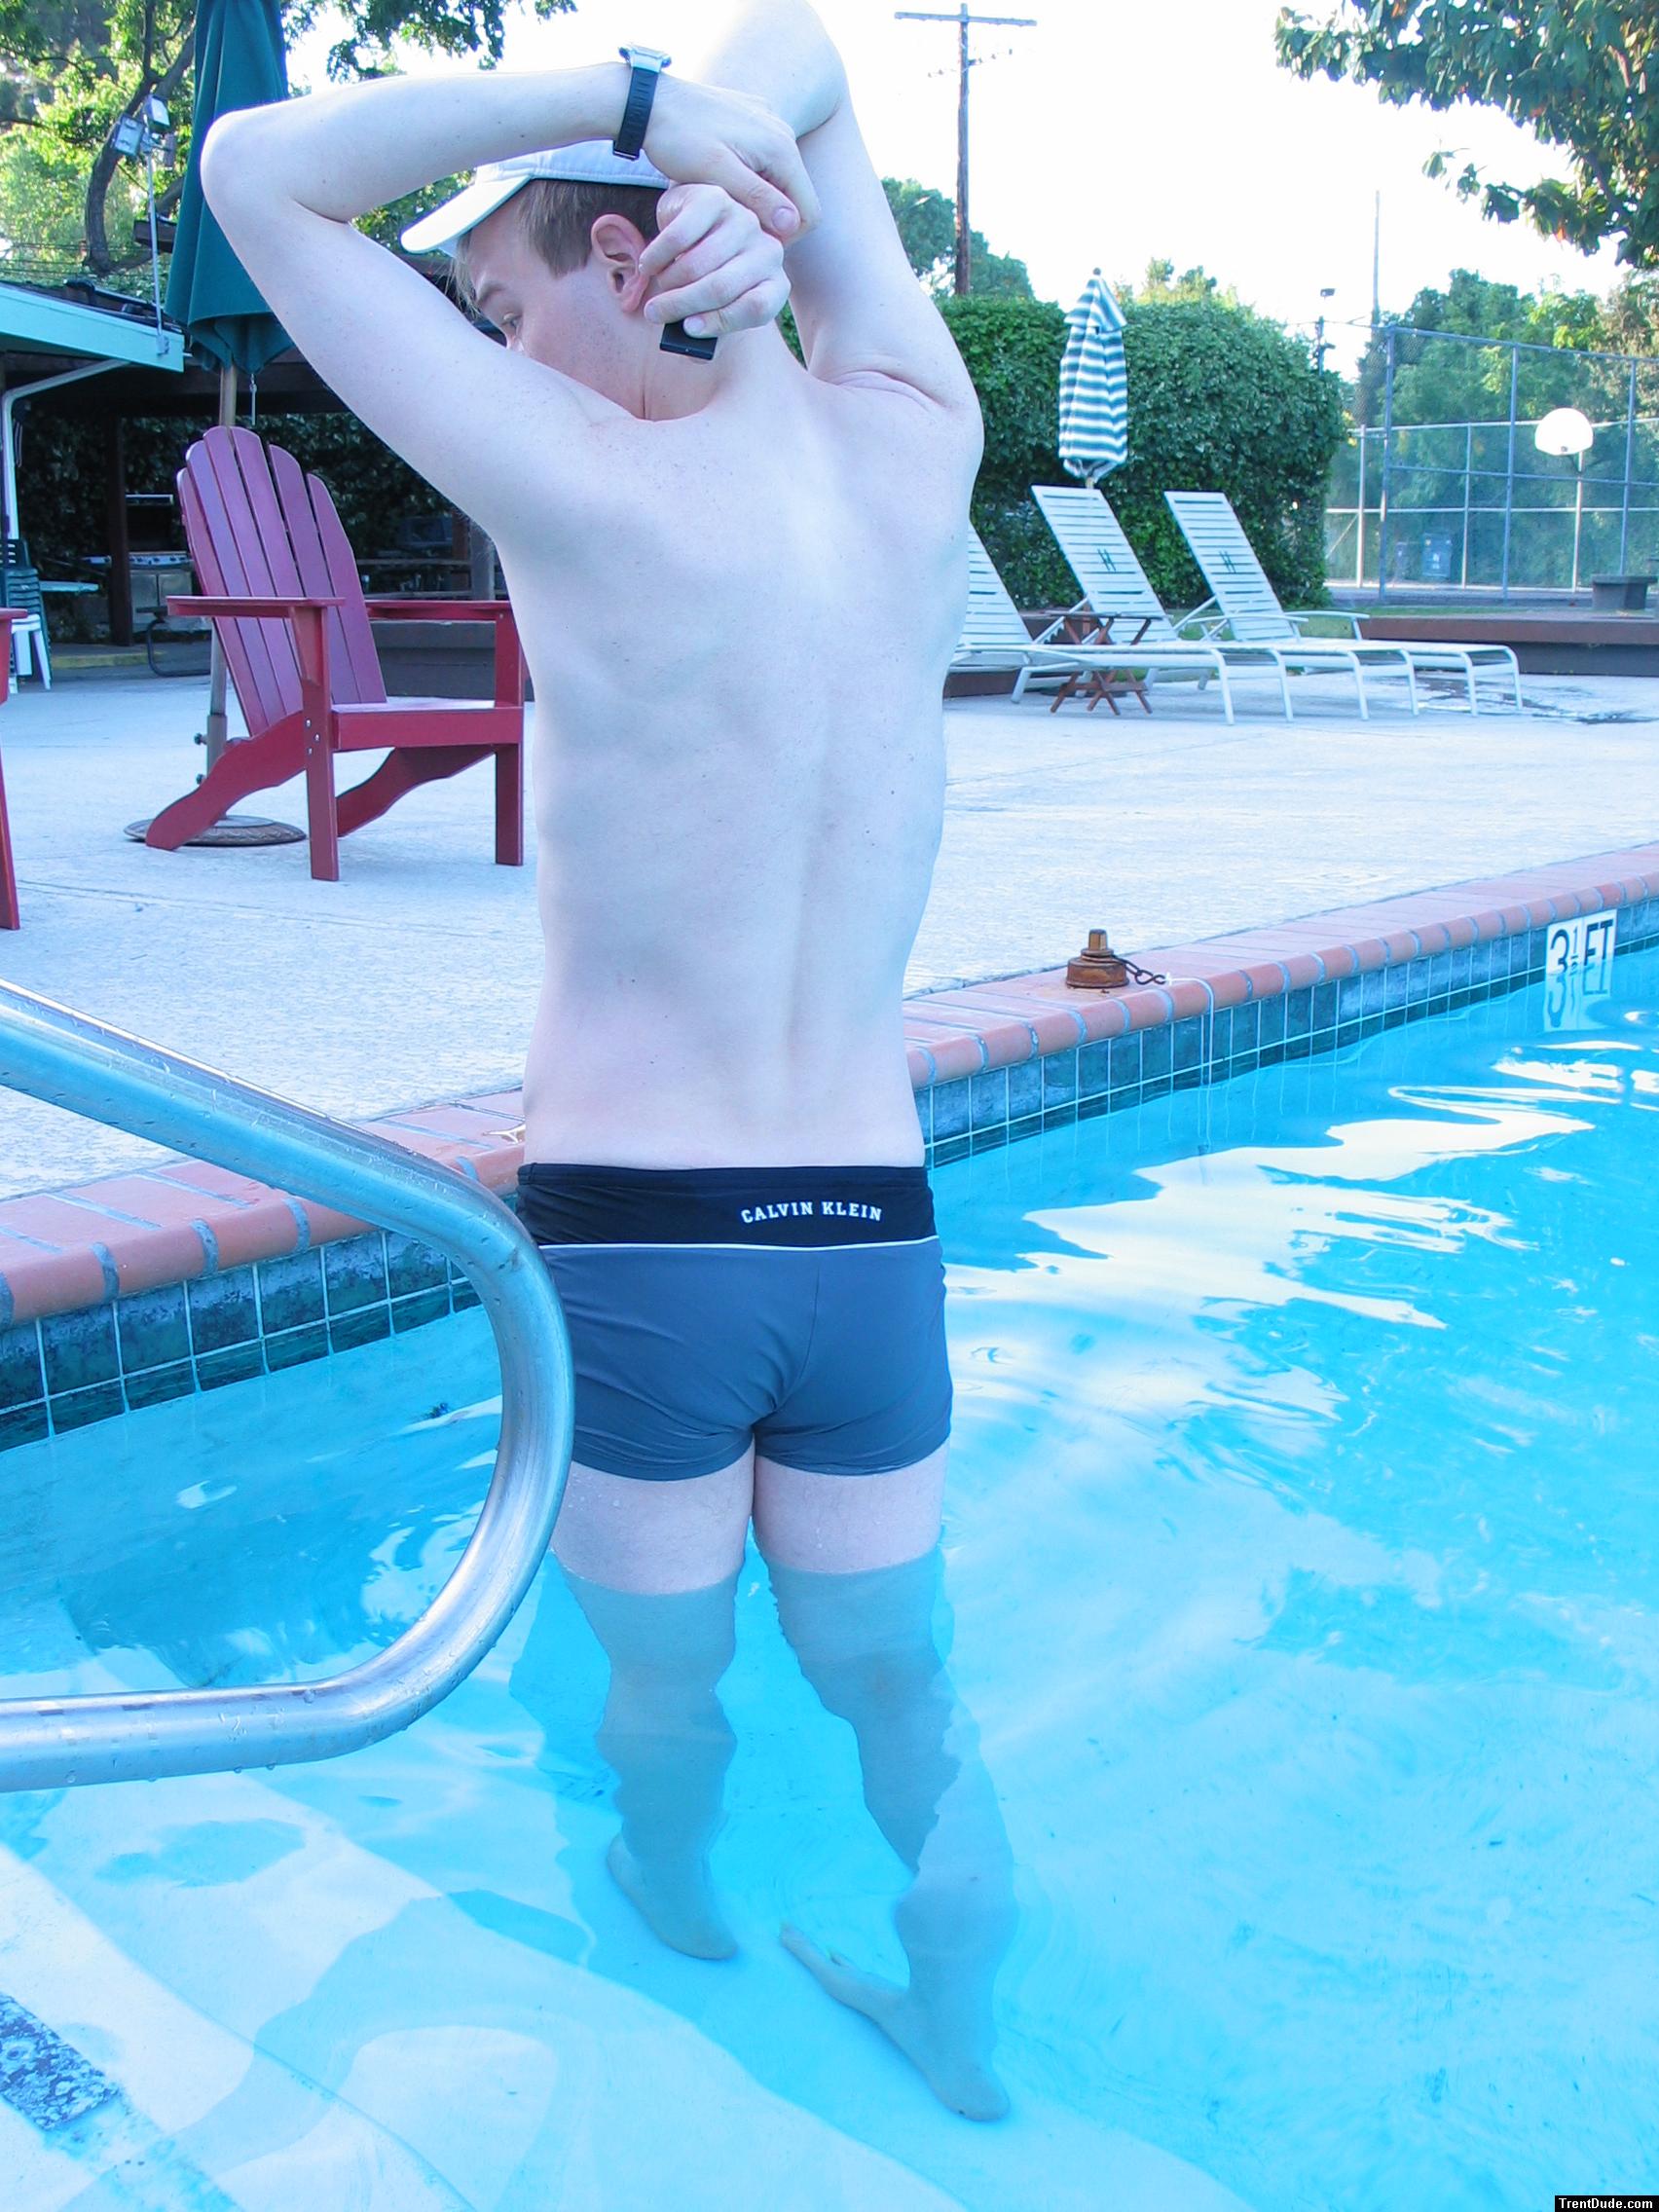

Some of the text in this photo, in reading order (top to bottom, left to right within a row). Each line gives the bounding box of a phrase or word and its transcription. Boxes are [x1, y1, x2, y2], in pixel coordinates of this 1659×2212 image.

[1584, 919, 1613, 966] FT
[741, 1201, 882, 1224] CALVIN KLEIN
